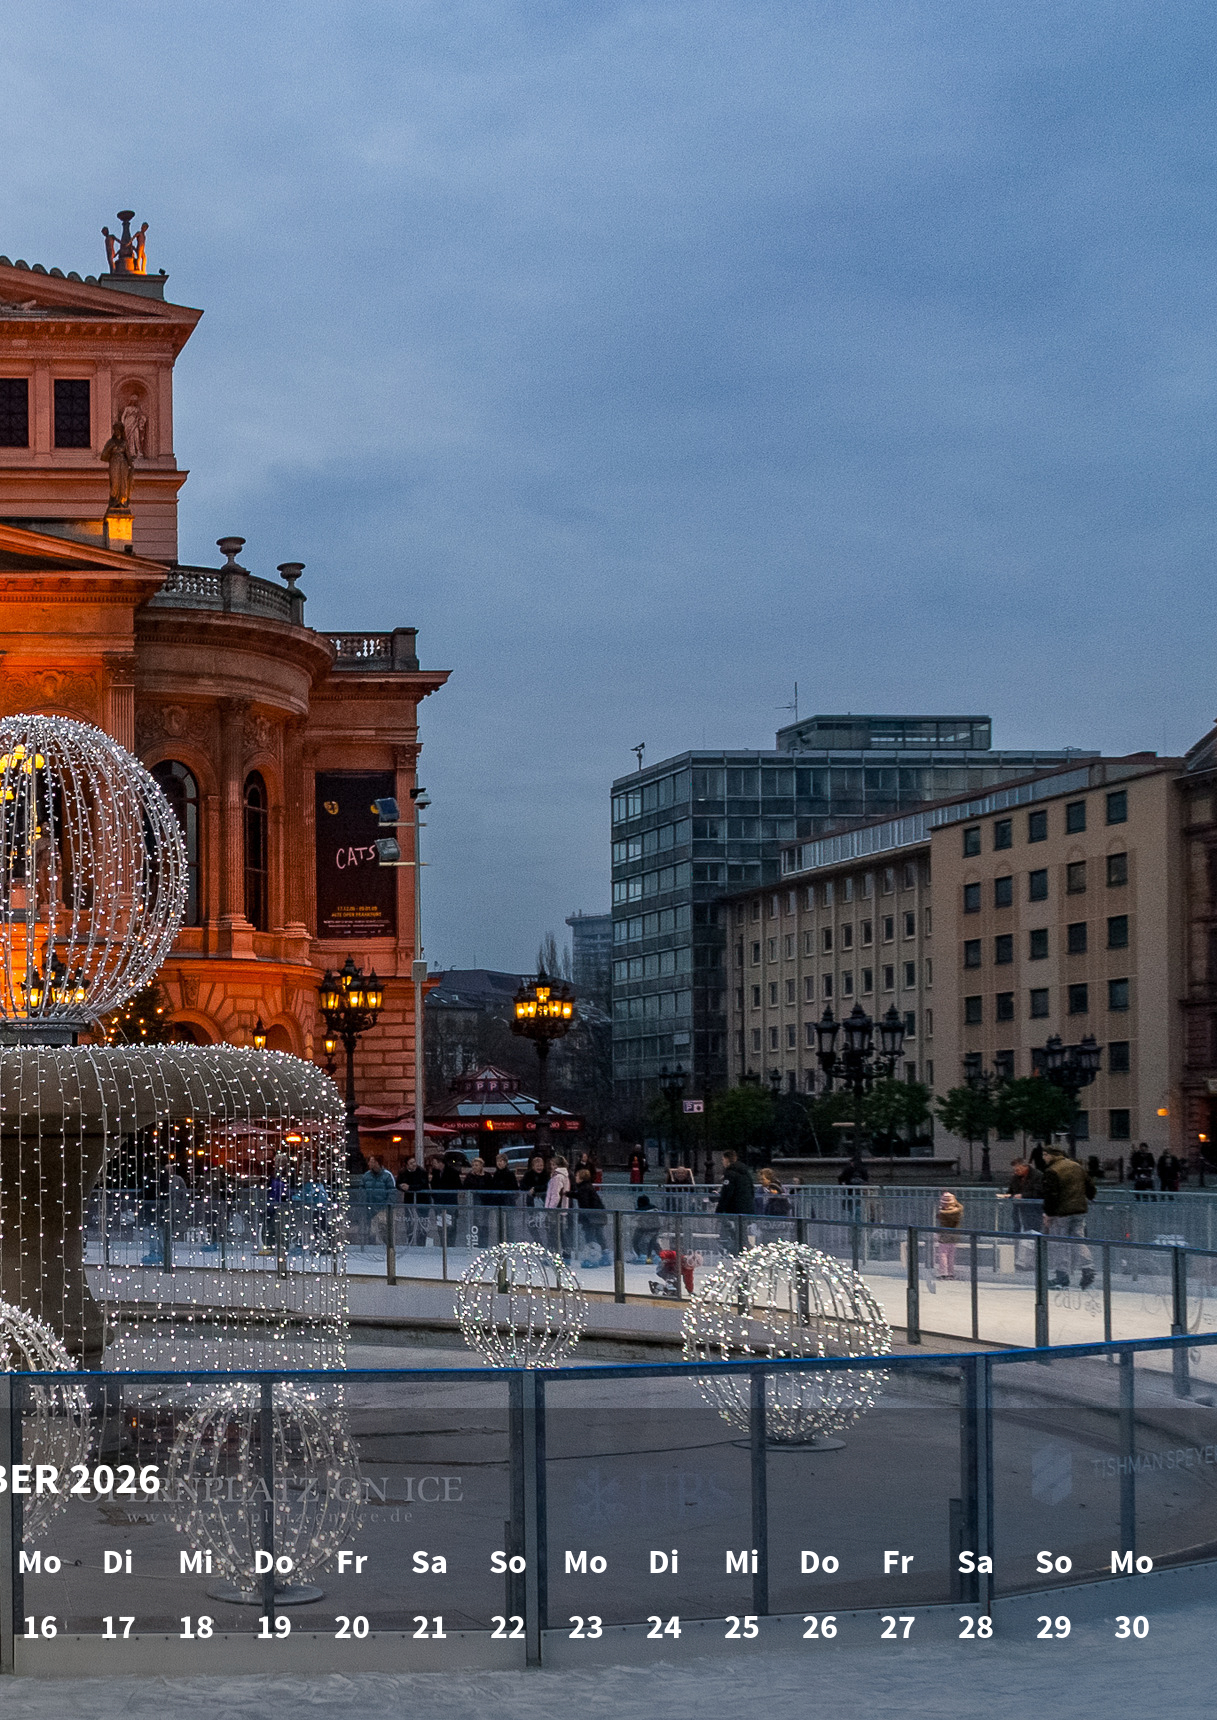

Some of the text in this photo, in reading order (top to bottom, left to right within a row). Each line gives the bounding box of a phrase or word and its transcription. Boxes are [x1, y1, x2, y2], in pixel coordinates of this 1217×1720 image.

[335, 844, 376, 869] CATS
[1091, 1444, 1217, 1478] TISHMAN SPEYE
[334, 1475, 389, 1503] ON
[402, 1476, 465, 1503] ICE
